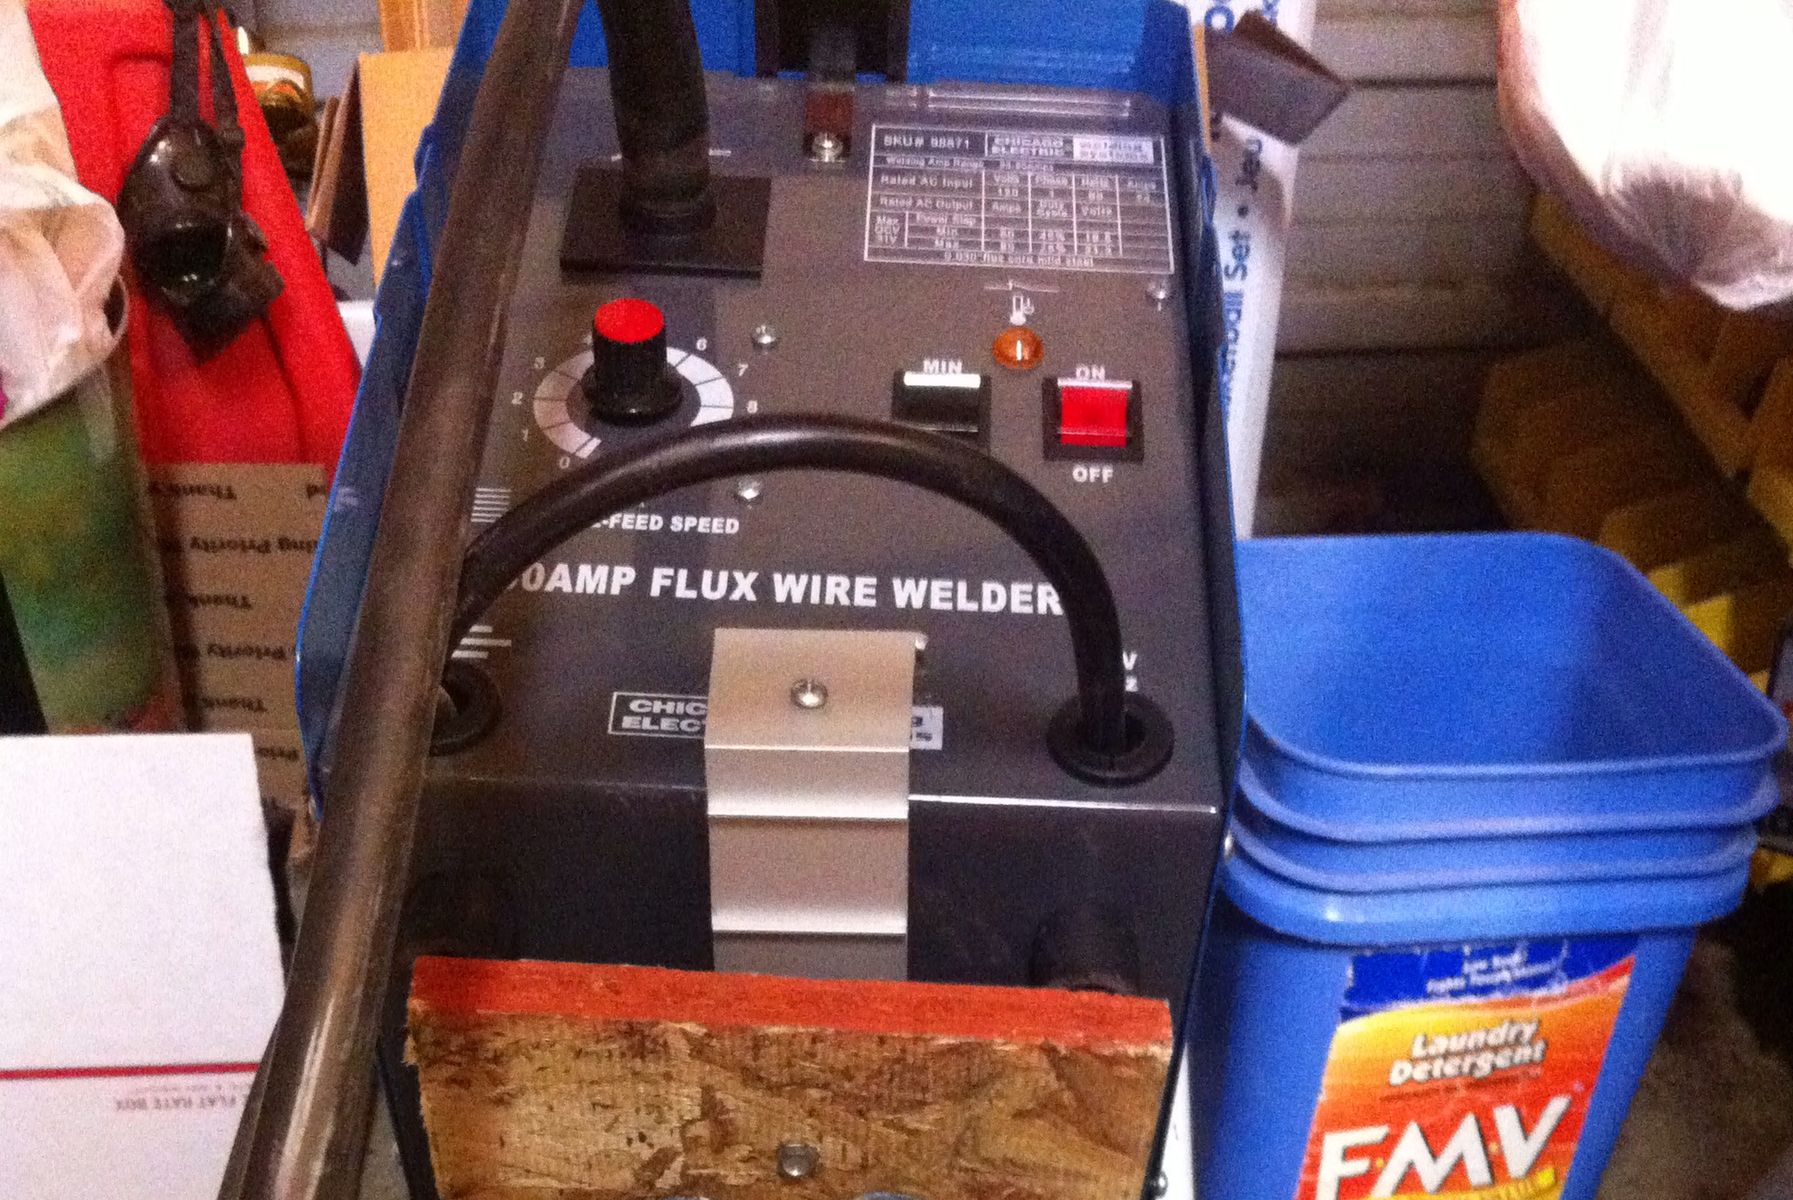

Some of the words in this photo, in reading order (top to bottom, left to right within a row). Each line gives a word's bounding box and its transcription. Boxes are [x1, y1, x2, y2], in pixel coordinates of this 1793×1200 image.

[737, 362, 749, 377] 7
[922, 358, 963, 376] MIN
[1075, 364, 1107, 381] ON
[1072, 466, 1114, 484] OFF
[670, 515, 741, 535] SPEED
[506, 561, 637, 597] 0AMP
[649, 566, 759, 602] FLUX
[772, 572, 878, 609] WIRE
[892, 577, 1065, 616] WELDER
[628, 698, 708, 716] CHIC
[621, 715, 707, 733] ELEC
[1411, 1018, 1541, 1060] Laundry
[1389, 1037, 1549, 1087] Detergent
